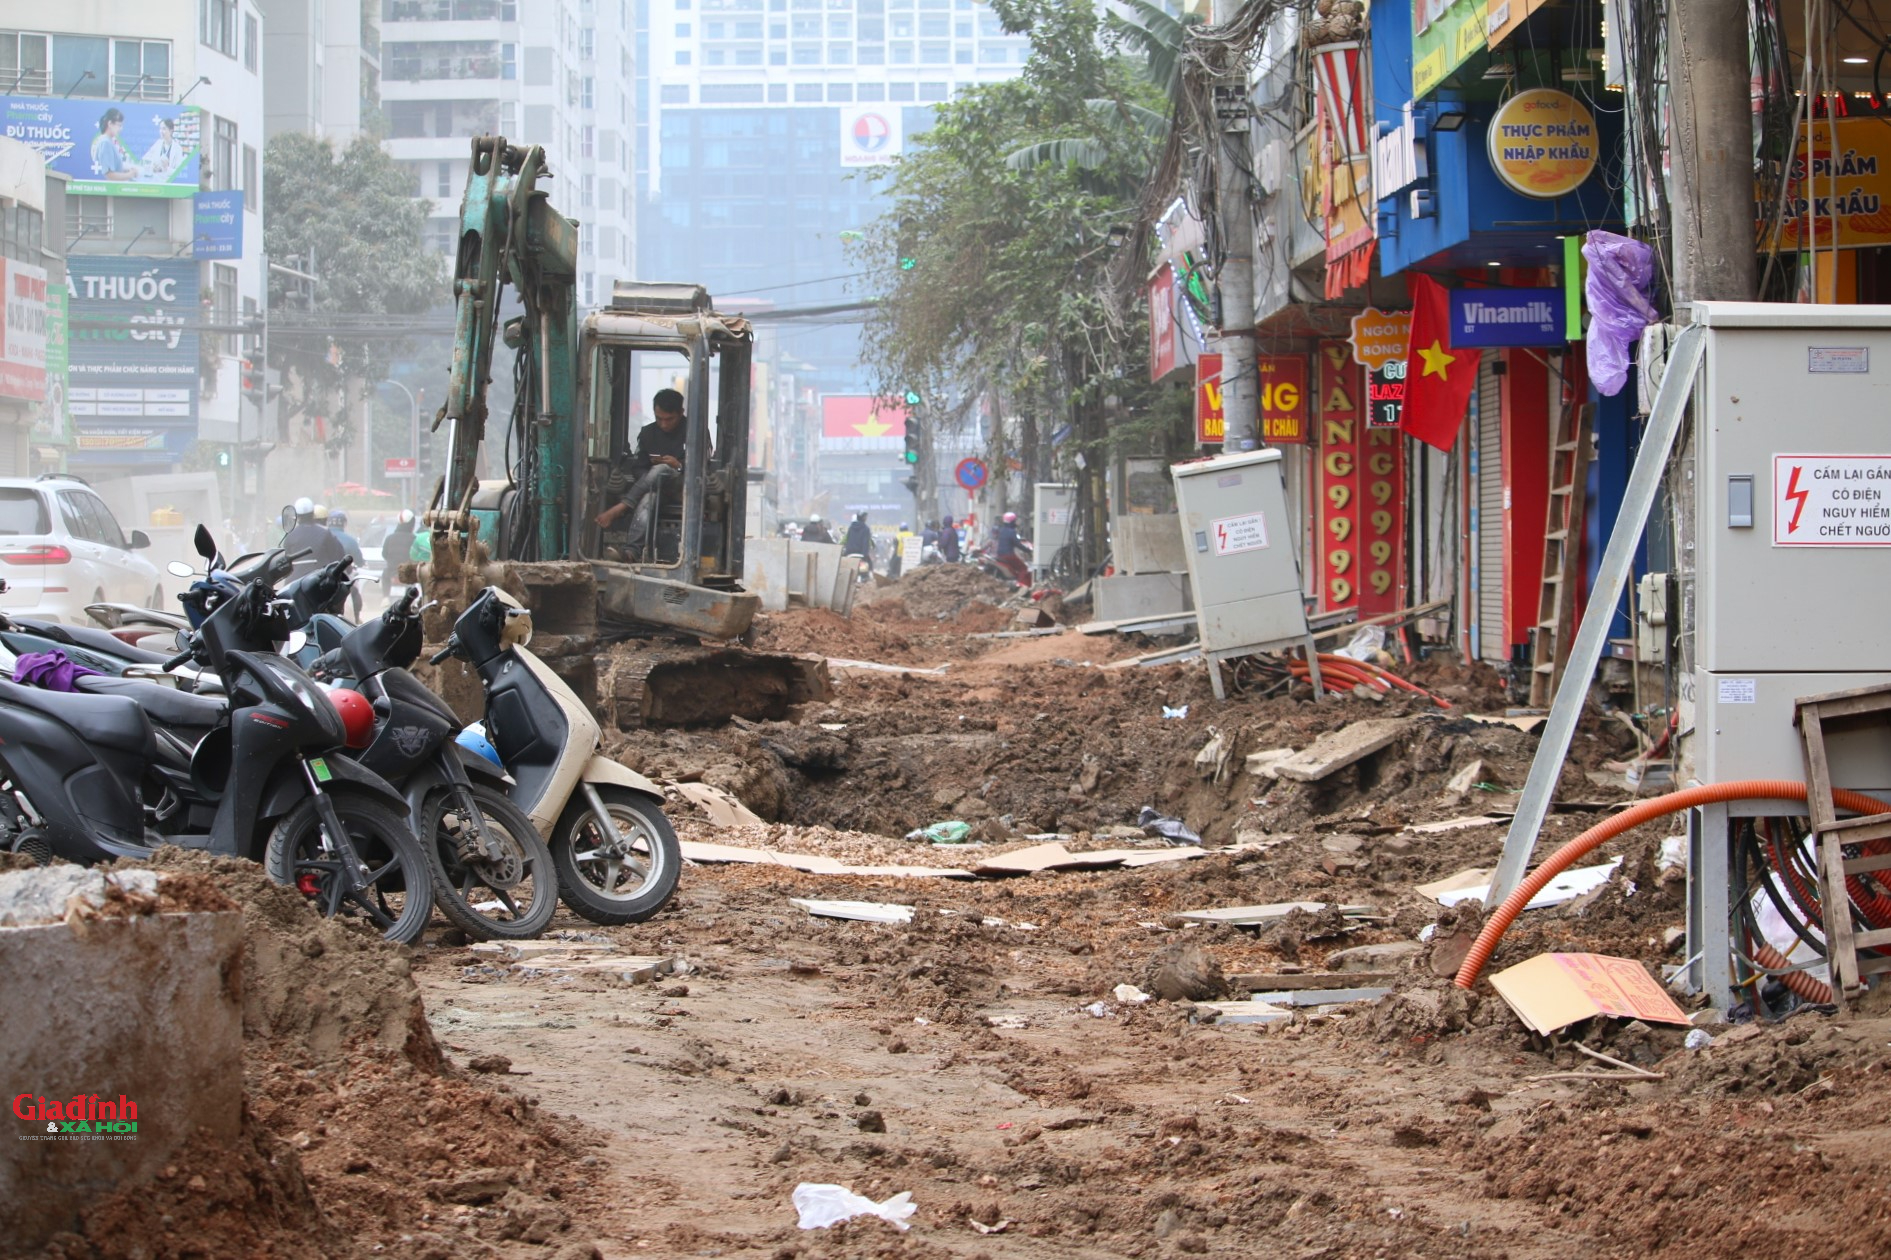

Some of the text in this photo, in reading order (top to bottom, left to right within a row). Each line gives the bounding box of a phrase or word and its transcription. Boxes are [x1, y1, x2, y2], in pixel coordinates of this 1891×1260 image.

[7, 122, 71, 140] ĐỦ THUỐC
[1502, 120, 1590, 140] THỰC PHẨM
[1503, 142, 1590, 163] NHẬP KHẨU
[82, 268, 177, 302] THUỐC
[1463, 302, 1553, 324] Vinamilk
[1813, 465, 1840, 479] CẤM
[1844, 469, 1863, 482] LẠI
[1832, 487, 1881, 502] CÓ ĐIỆN
[1823, 503, 1890, 518] NGUY HIỂM
[1819, 522, 1852, 536] CHẾT
